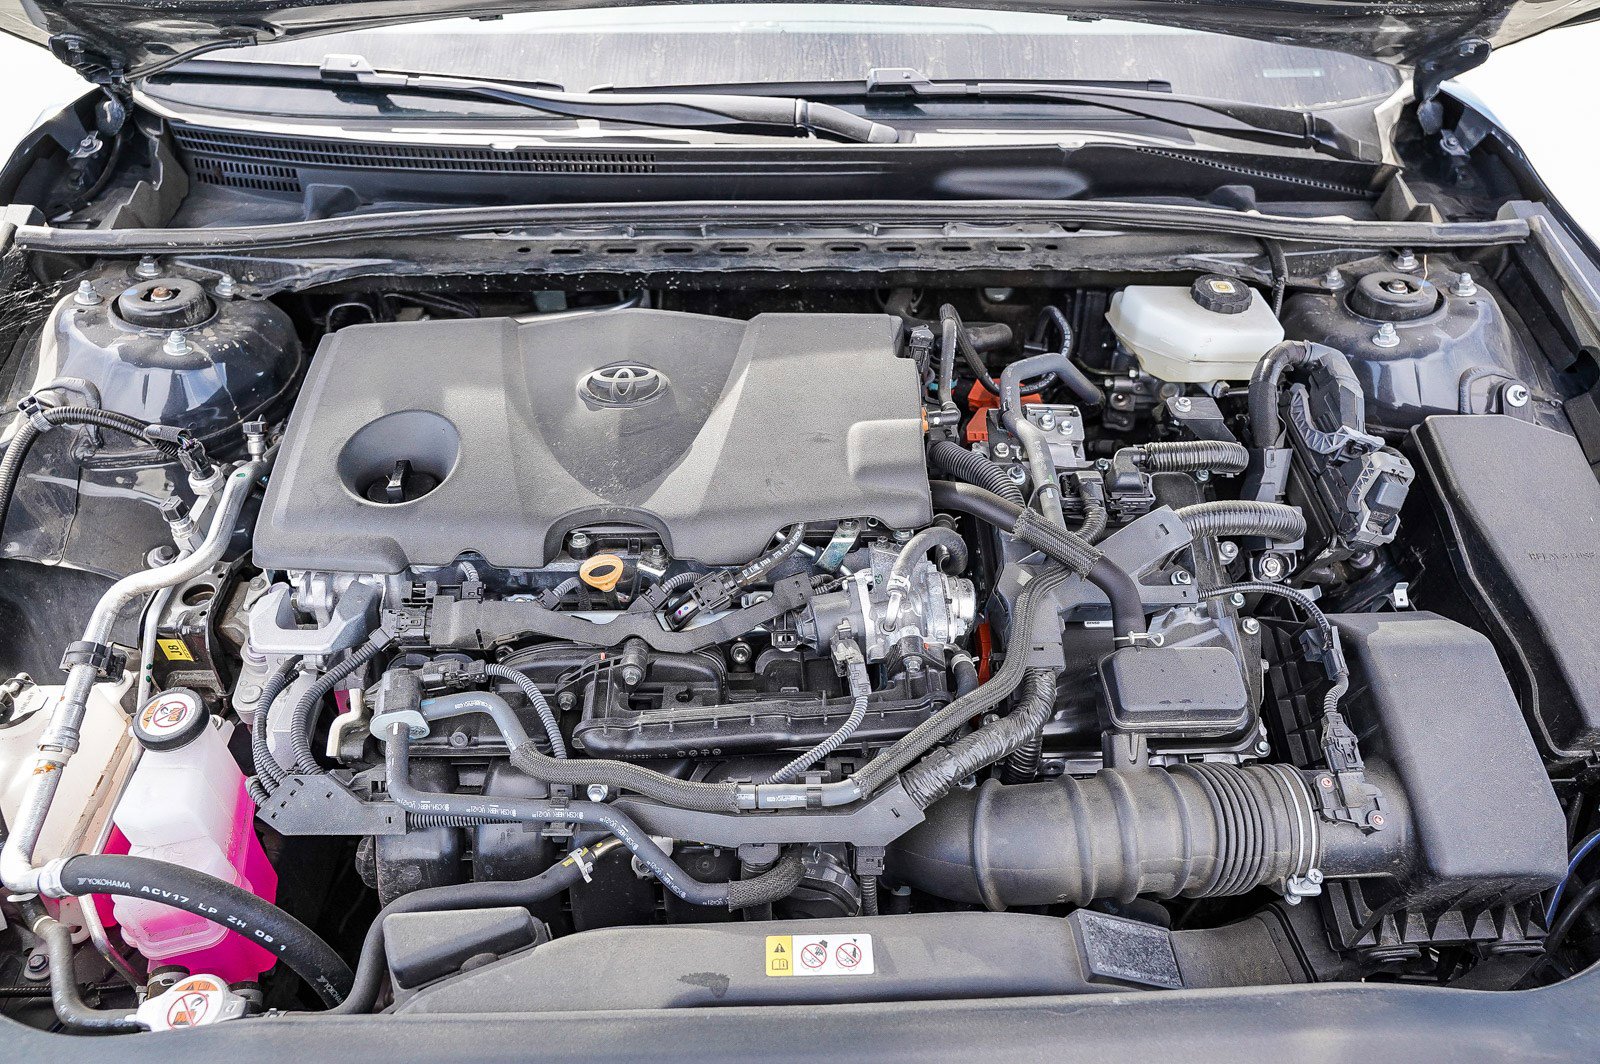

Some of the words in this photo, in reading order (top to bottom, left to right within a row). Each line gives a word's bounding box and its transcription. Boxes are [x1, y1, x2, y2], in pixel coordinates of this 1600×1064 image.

[88, 878, 131, 889] YOKOHAMA
[140, 885, 189, 903] ACV17
[198, 903, 218, 914] LP
[227, 915, 247, 928] ZH
